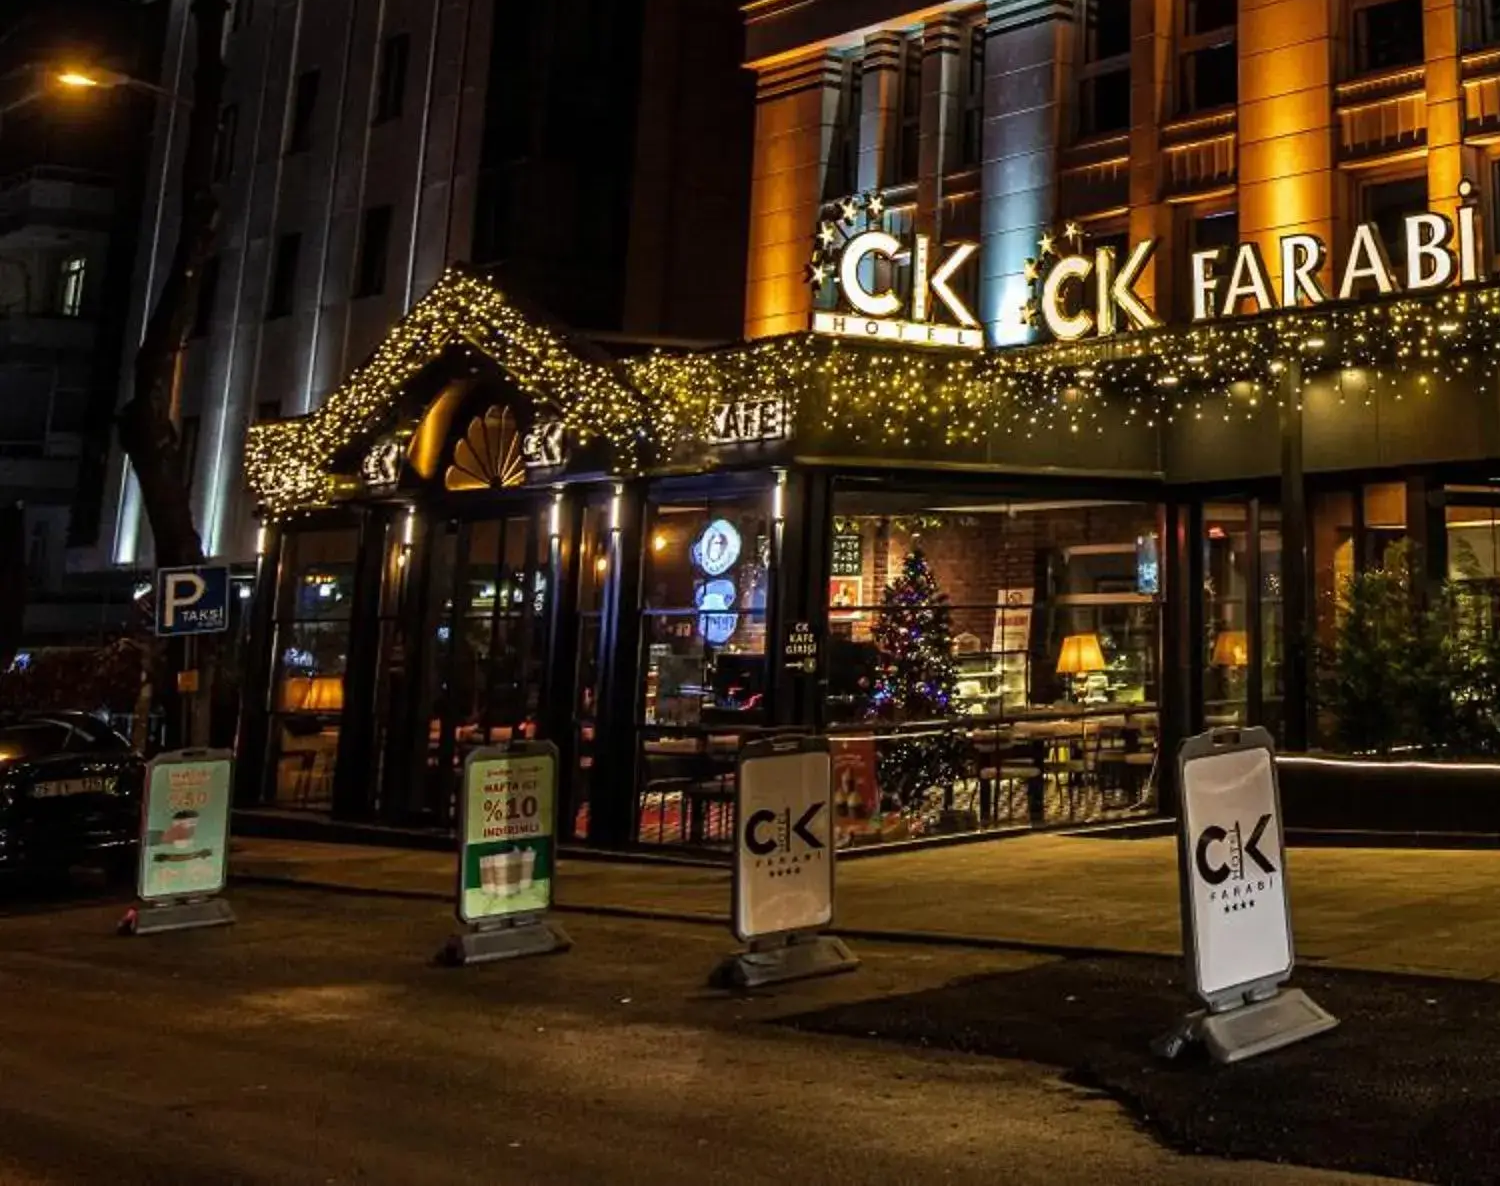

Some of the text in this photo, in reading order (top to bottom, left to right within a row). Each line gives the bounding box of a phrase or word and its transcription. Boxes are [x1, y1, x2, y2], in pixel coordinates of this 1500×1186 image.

[841, 231, 982, 329] CK
[1042, 238, 1164, 340] CK
[833, 316, 966, 345] HOTEL
[164, 573, 206, 626] P
[789, 633, 814, 643] KAFE
[795, 622, 809, 633] CK
[483, 796, 538, 822] %10
[745, 801, 826, 855] CK
[1196, 814, 1276, 884] CK
